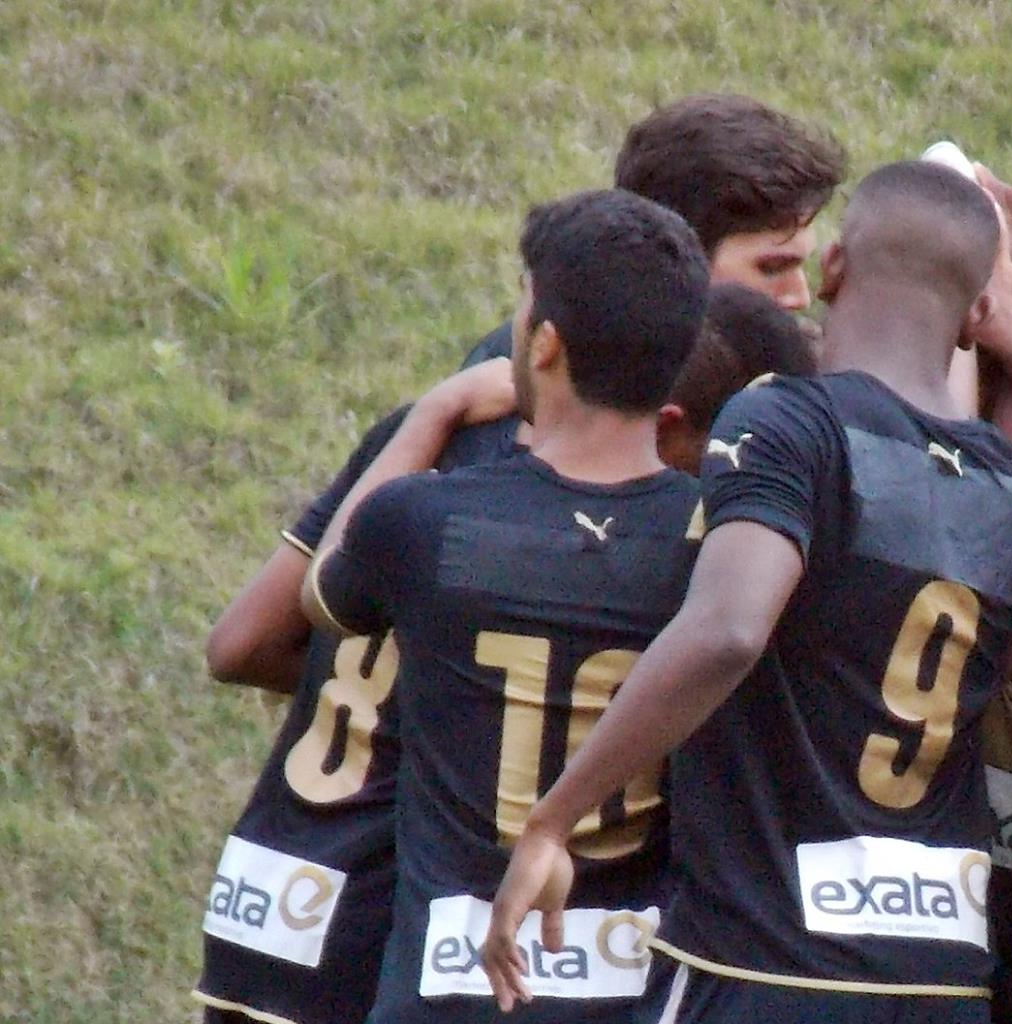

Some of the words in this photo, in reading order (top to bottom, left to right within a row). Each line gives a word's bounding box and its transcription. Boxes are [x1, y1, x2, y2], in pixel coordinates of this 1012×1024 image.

[284, 629, 399, 803] 8
[858, 580, 980, 808] 9
[206, 874, 271, 930] ata
[811, 872, 958, 919] exata
